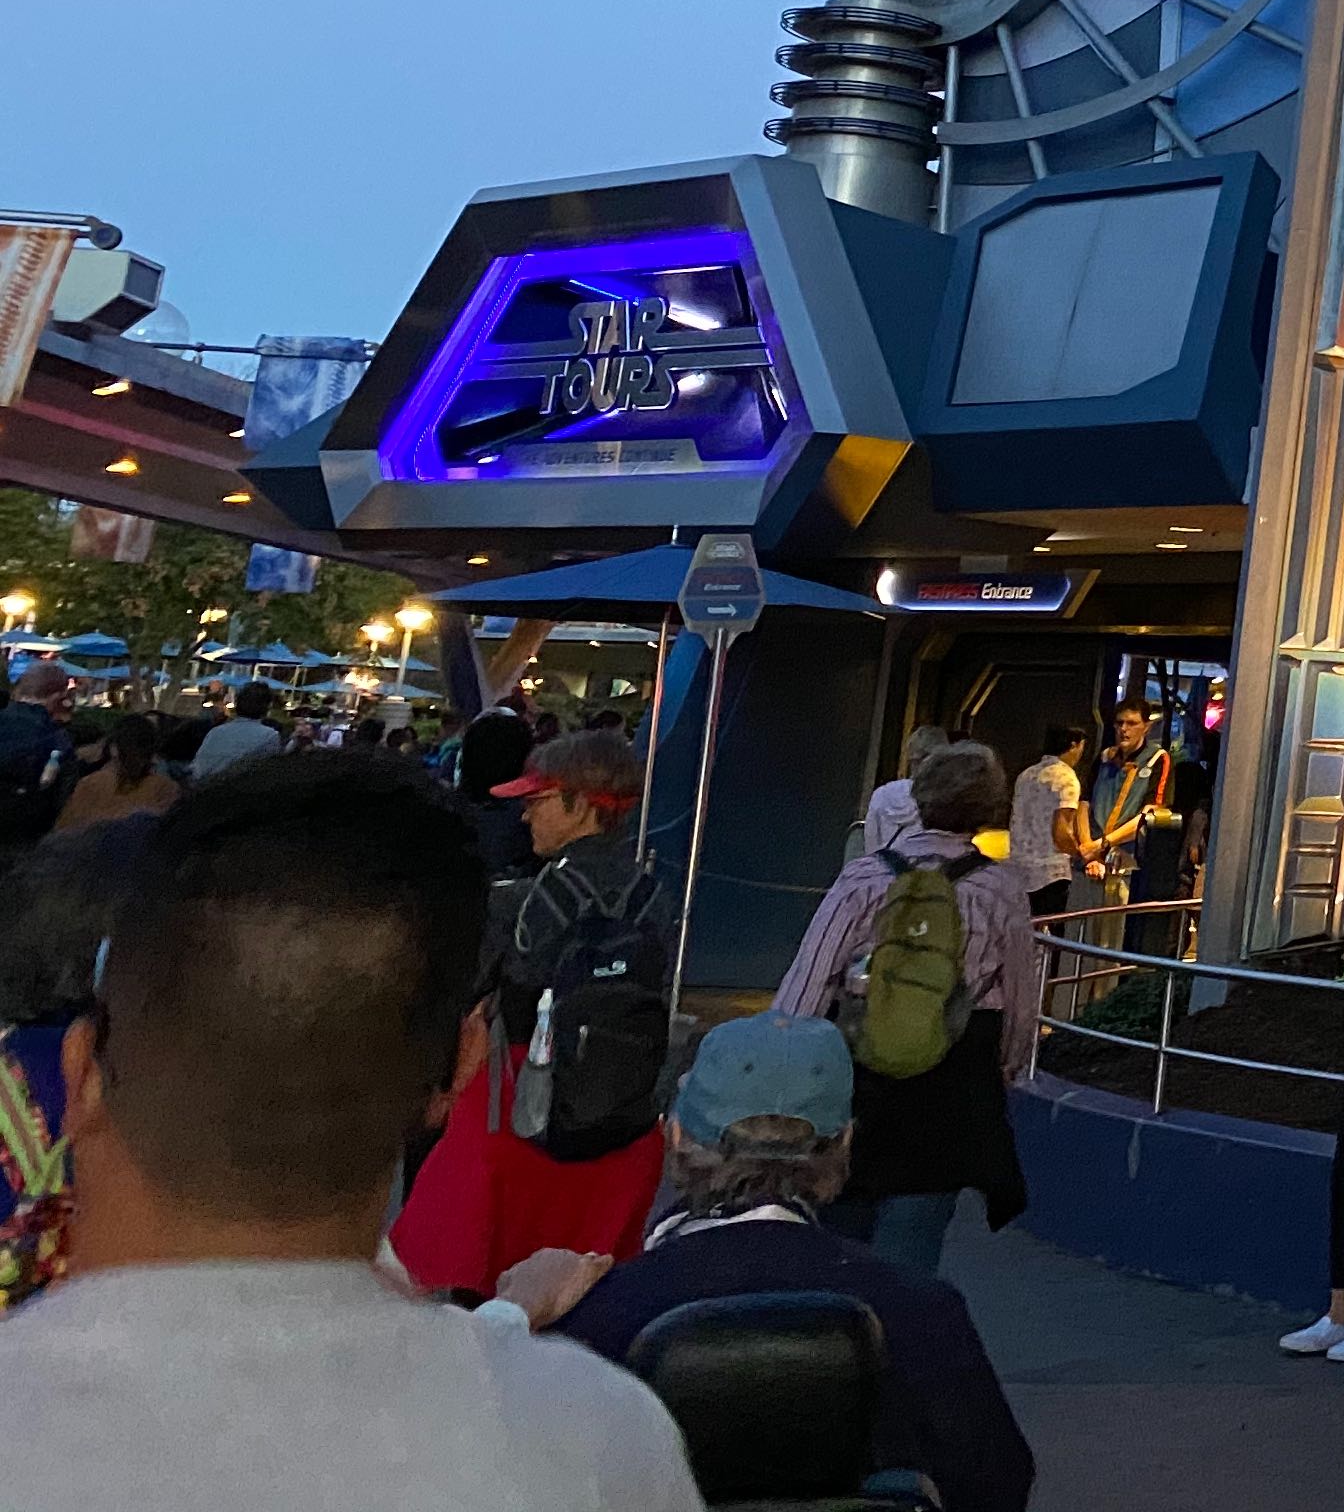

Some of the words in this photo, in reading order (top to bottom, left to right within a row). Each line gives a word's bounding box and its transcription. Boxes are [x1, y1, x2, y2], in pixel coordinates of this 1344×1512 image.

[568, 296, 672, 357] STAR
[538, 354, 677, 415] TOURS
[981, 582, 1034, 600] Entrance
